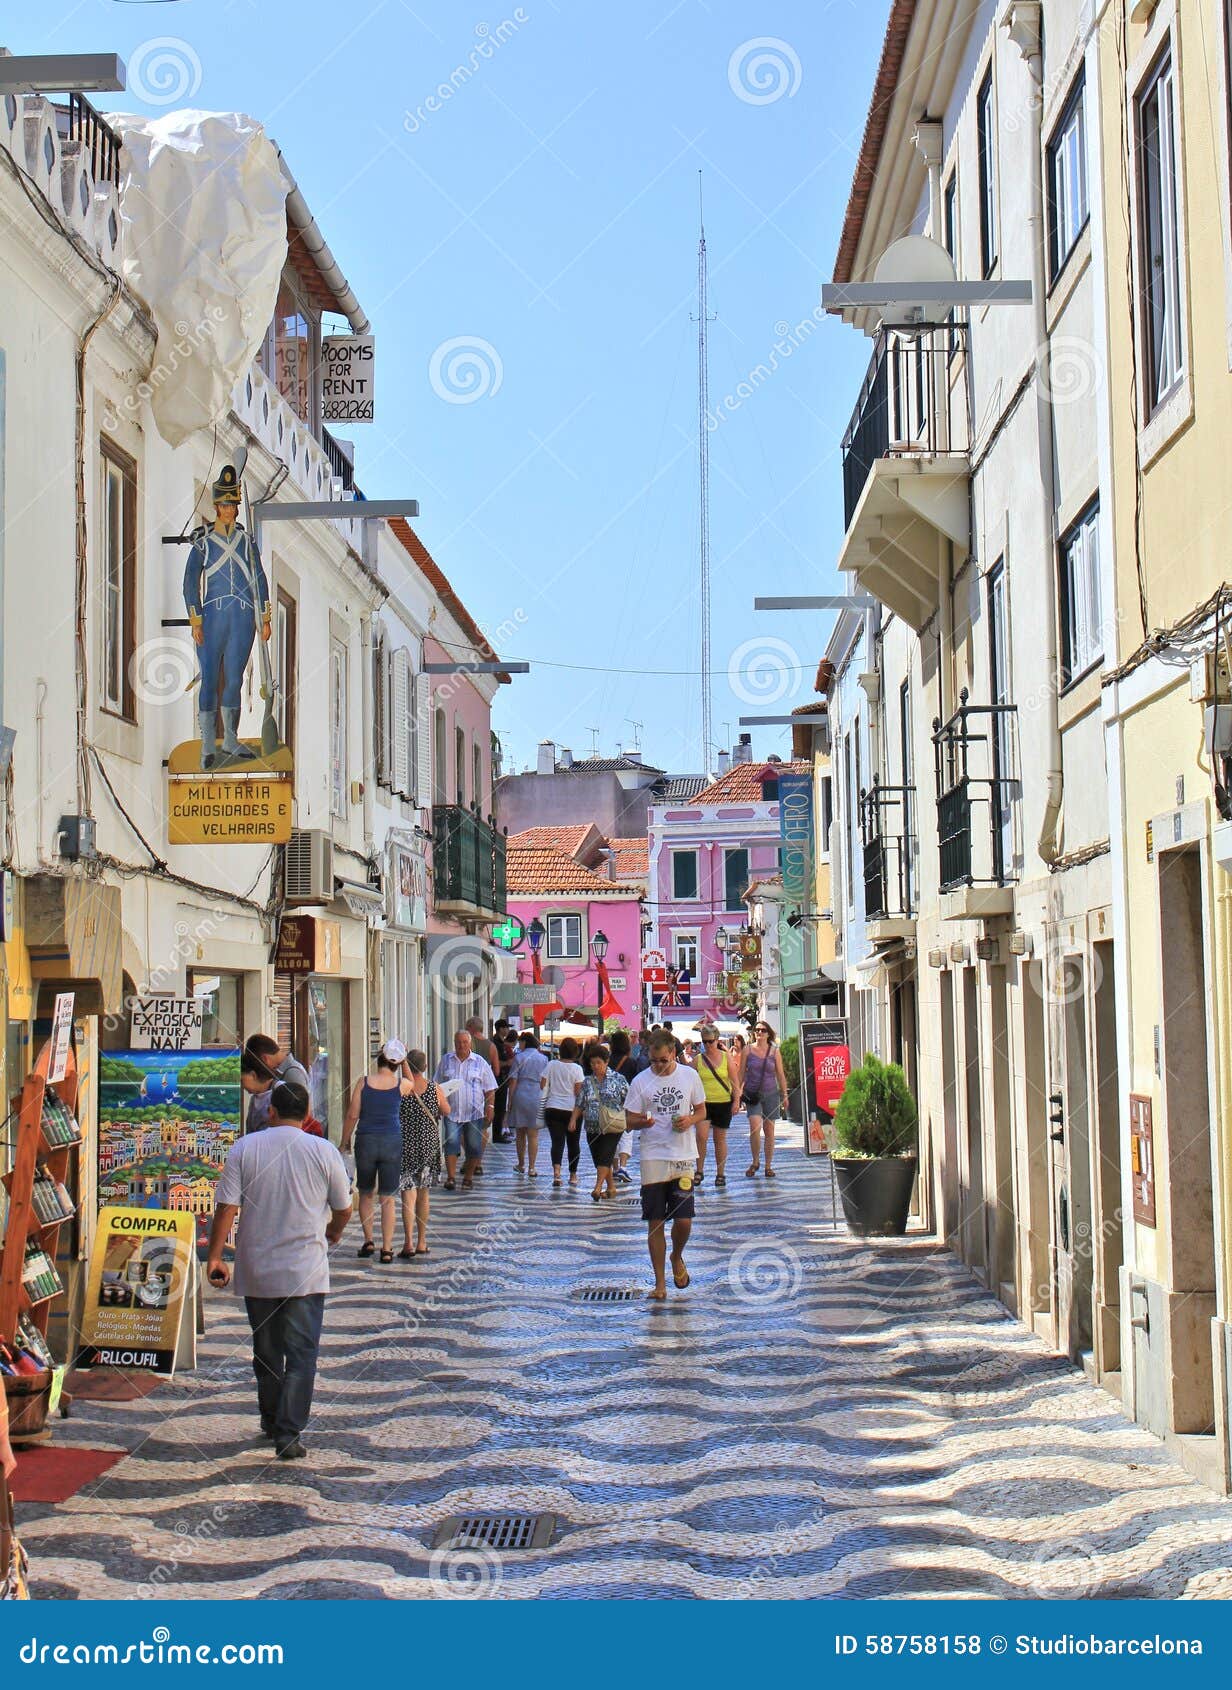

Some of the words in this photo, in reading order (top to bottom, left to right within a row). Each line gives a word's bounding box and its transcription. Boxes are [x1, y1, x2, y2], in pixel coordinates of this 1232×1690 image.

[321, 342, 374, 362] ROOMS
[329, 364, 351, 377] FOR
[323, 379, 368, 396] RENT
[173, 804, 269, 817] CURIOSIDADES
[278, 803, 287, 815] E
[202, 822, 276, 835] VELHARIAS
[137, 999, 196, 1014] VISITE
[150, 1036, 188, 1050] NAIF
[820, 1055, 846, 1067] -30%
[821, 1065, 846, 1075] HOJE
[652, 1086, 684, 1103] HILFIGER
[110, 1216, 178, 1233] COMPRA
[98, 1311, 117, 1320] Ouro
[121, 1312, 141, 1321] Prata
[97, 1321, 129, 1332] Relógios
[133, 1323, 161, 1332] Moedas
[94, 1331, 124, 1341] Cautelas
[125, 1333, 135, 1341] de
[136, 1333, 162, 1343] Penhor
[90, 1350, 160, 1367] ARLLOUFIL
